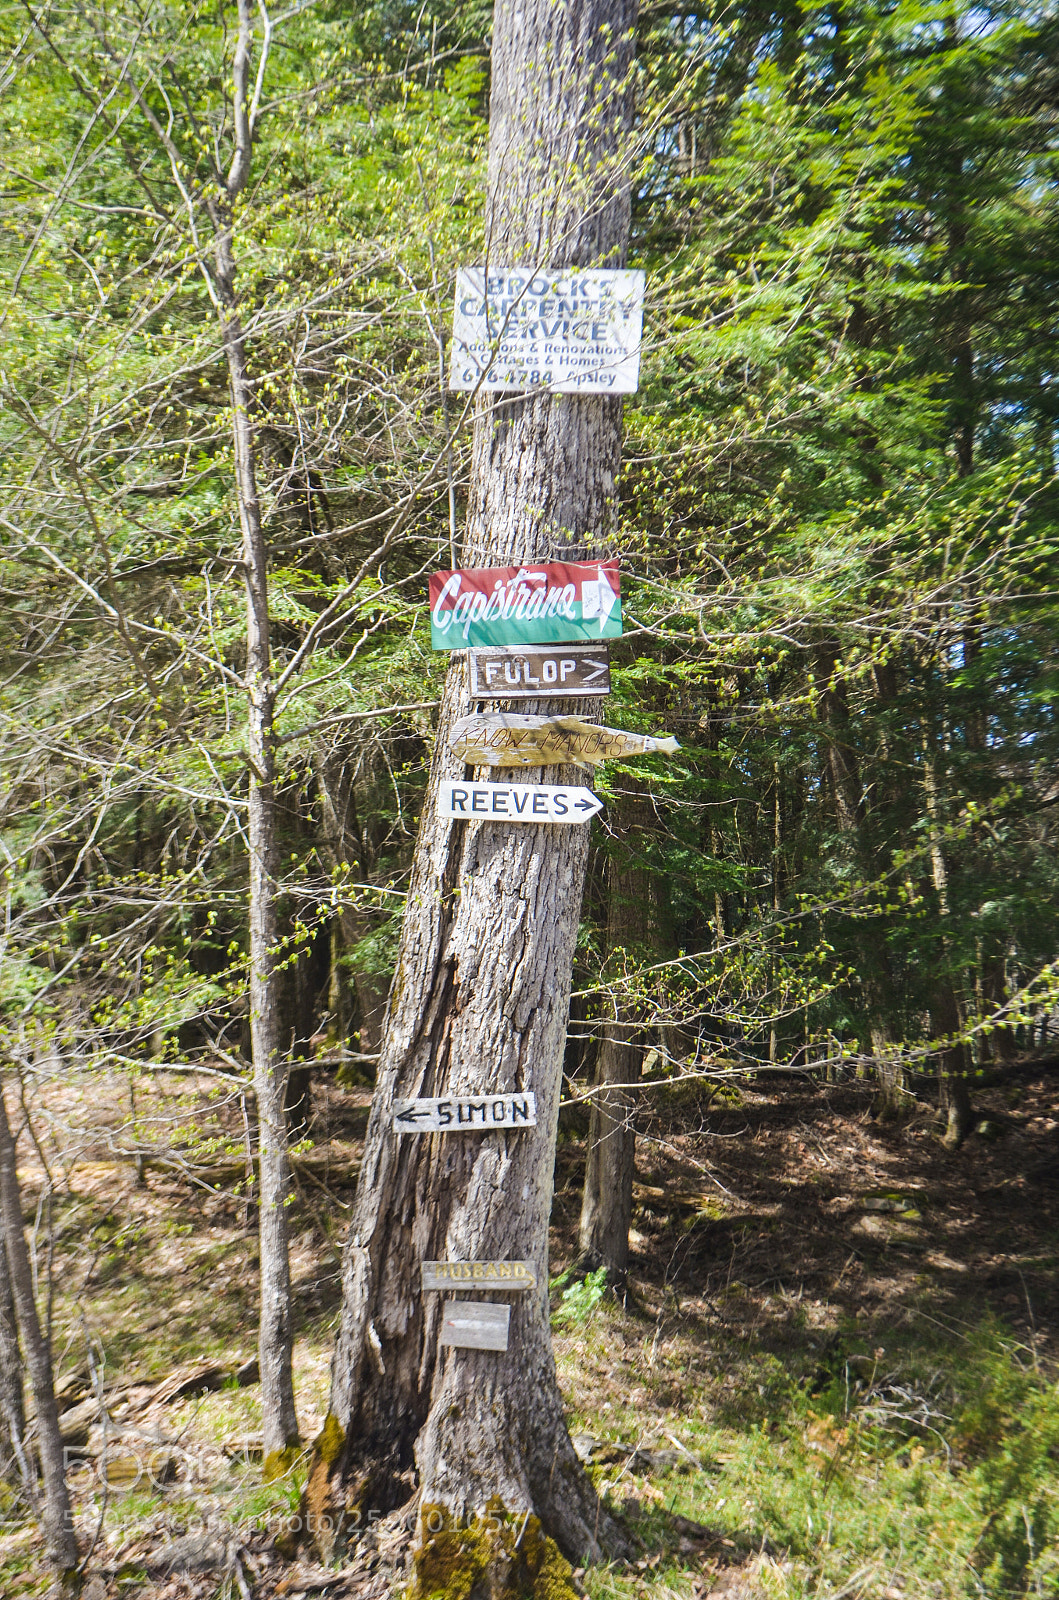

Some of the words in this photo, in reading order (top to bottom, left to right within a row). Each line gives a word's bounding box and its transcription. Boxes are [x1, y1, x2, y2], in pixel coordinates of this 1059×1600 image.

[459, 297, 636, 320] CARPENTRY
[486, 320, 608, 341] SERVICE
[458, 343, 524, 354] Addons
[529, 343, 538, 353] &
[544, 343, 629, 355] Renovations
[480, 354, 539, 366] Cttages
[544, 355, 554, 365] &
[559, 355, 606, 366] Homes
[566, 370, 616, 387] Apsley
[433, 568, 576, 640] Capistrano
[485, 659, 576, 684] FULOP
[453, 727, 529, 748] KNOW
[540, 730, 628, 756] MANORS
[451, 788, 569, 815] REEVES
[437, 1100, 529, 1125] SIMON
[435, 1262, 527, 1279] HUSBAND
